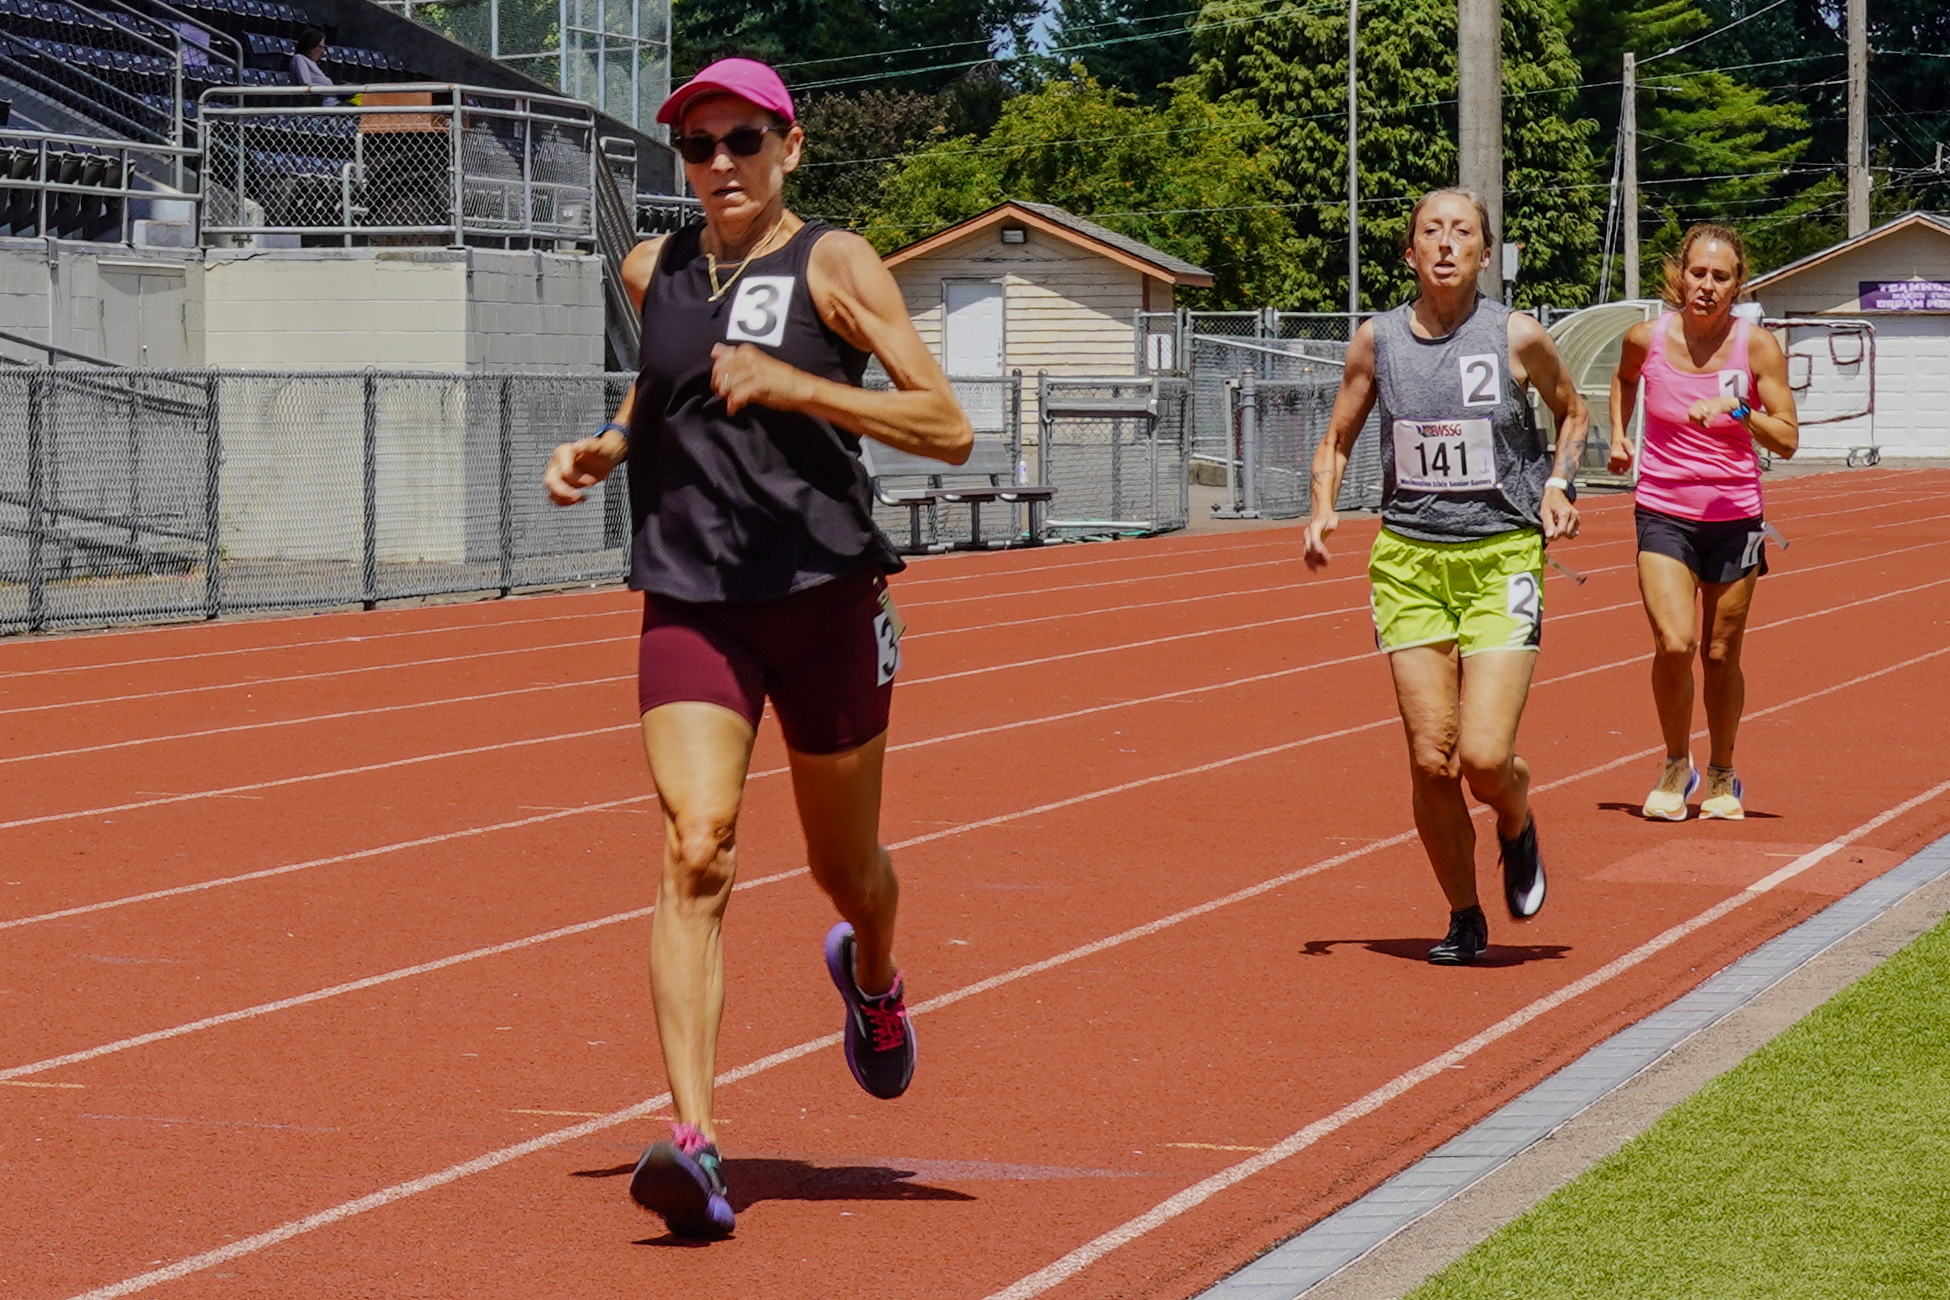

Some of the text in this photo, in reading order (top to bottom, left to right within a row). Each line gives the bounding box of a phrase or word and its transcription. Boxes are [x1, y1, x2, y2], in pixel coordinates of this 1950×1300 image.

[737, 283, 779, 338] 3
[1465, 360, 1496, 403] 2
[1724, 374, 1740, 398] 1
[1435, 424, 1463, 437] WSSG
[1414, 441, 1468, 477] 141
[1511, 576, 1535, 619] 2
[880, 615, 898, 677] 3
